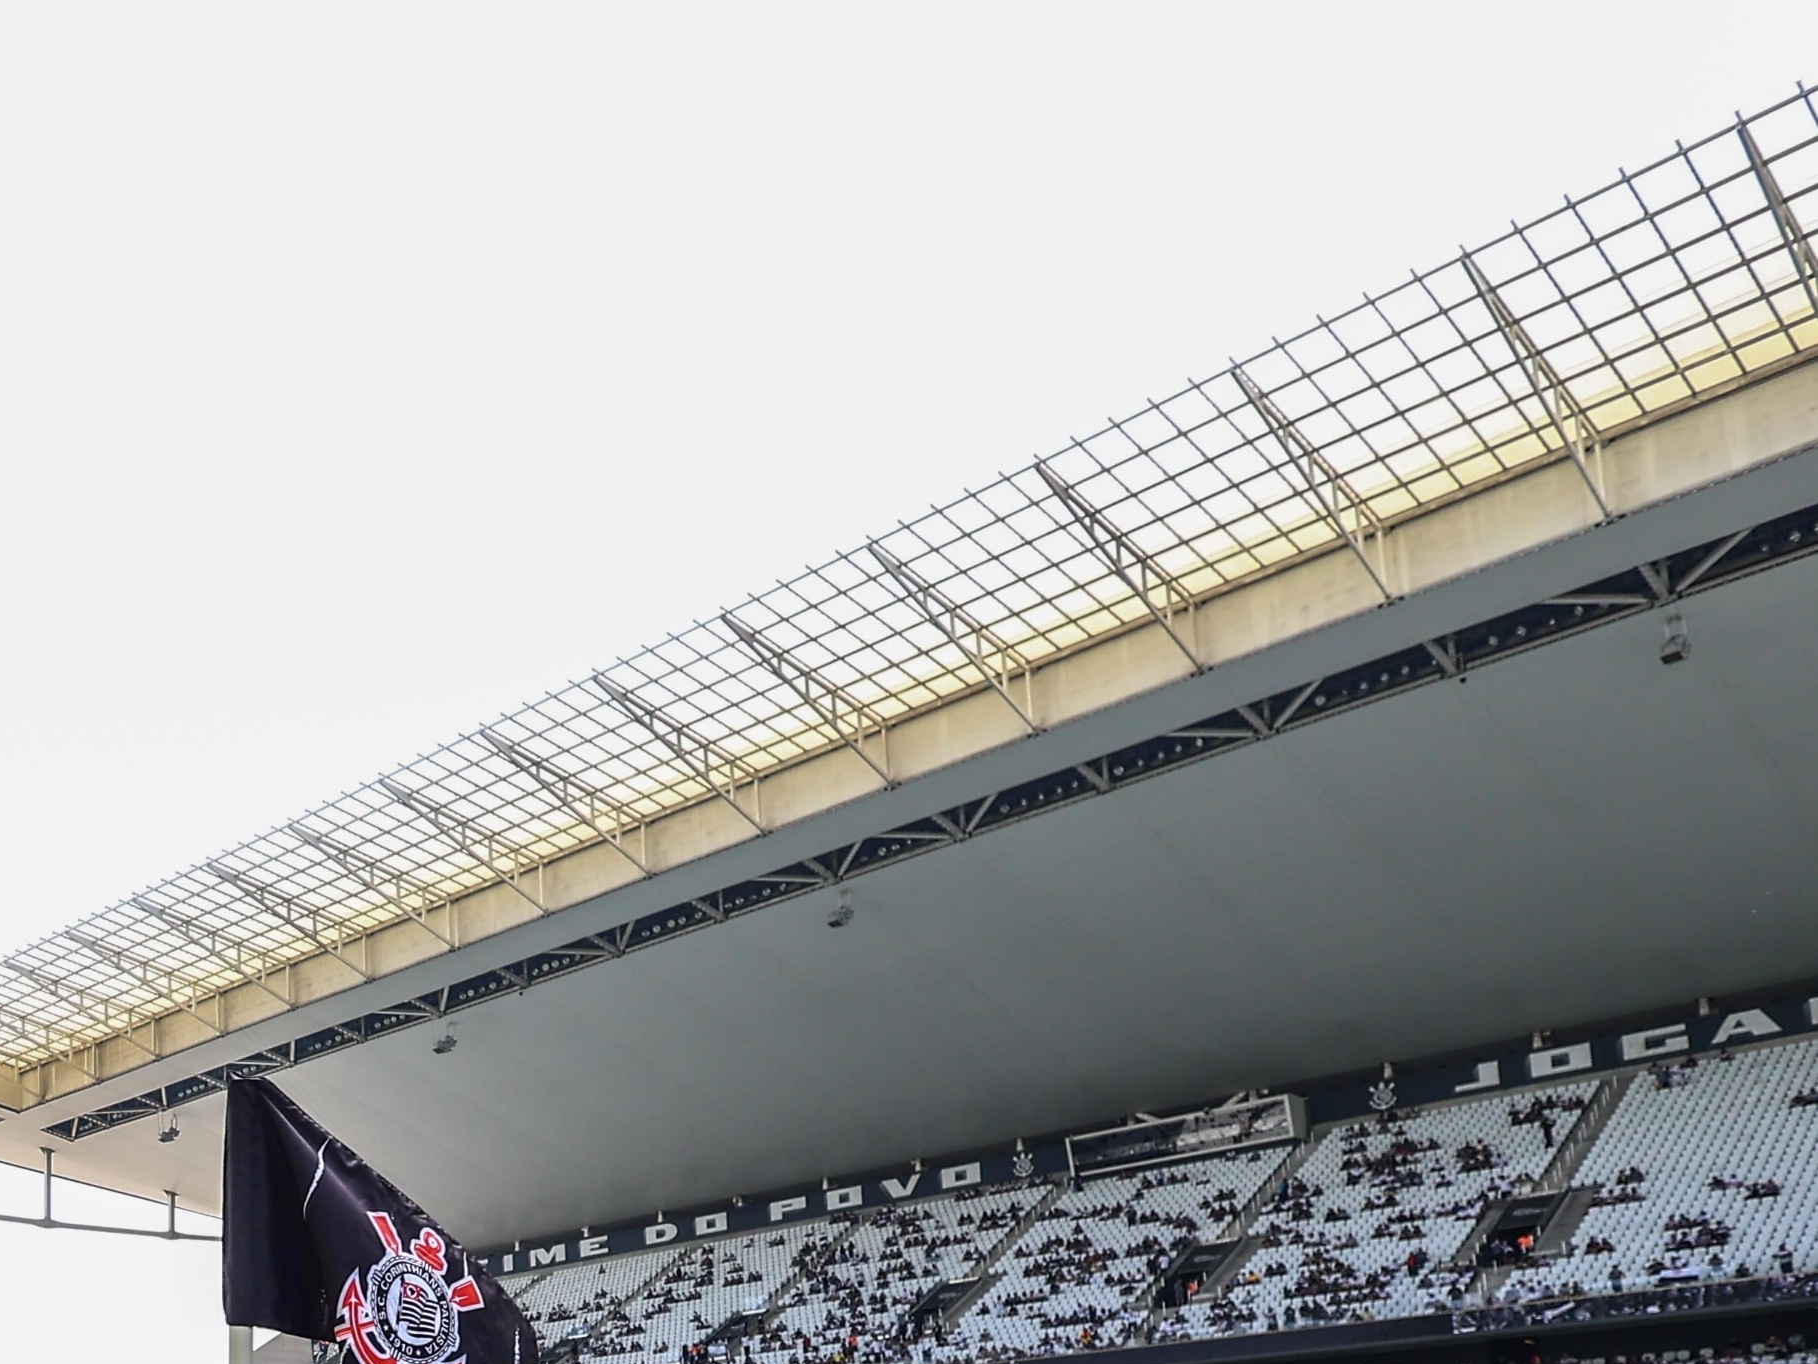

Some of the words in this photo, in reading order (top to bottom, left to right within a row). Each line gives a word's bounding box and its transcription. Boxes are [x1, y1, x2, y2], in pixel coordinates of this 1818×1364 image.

[1455, 997, 1818, 1092] JOGA
[645, 1212, 727, 1246] DO
[771, 1162, 981, 1221] POVO
[380, 1263, 443, 1297] CORINTHIANS
[423, 1300, 449, 1354] PAULISTA
[388, 1333, 414, 1355] 1910
